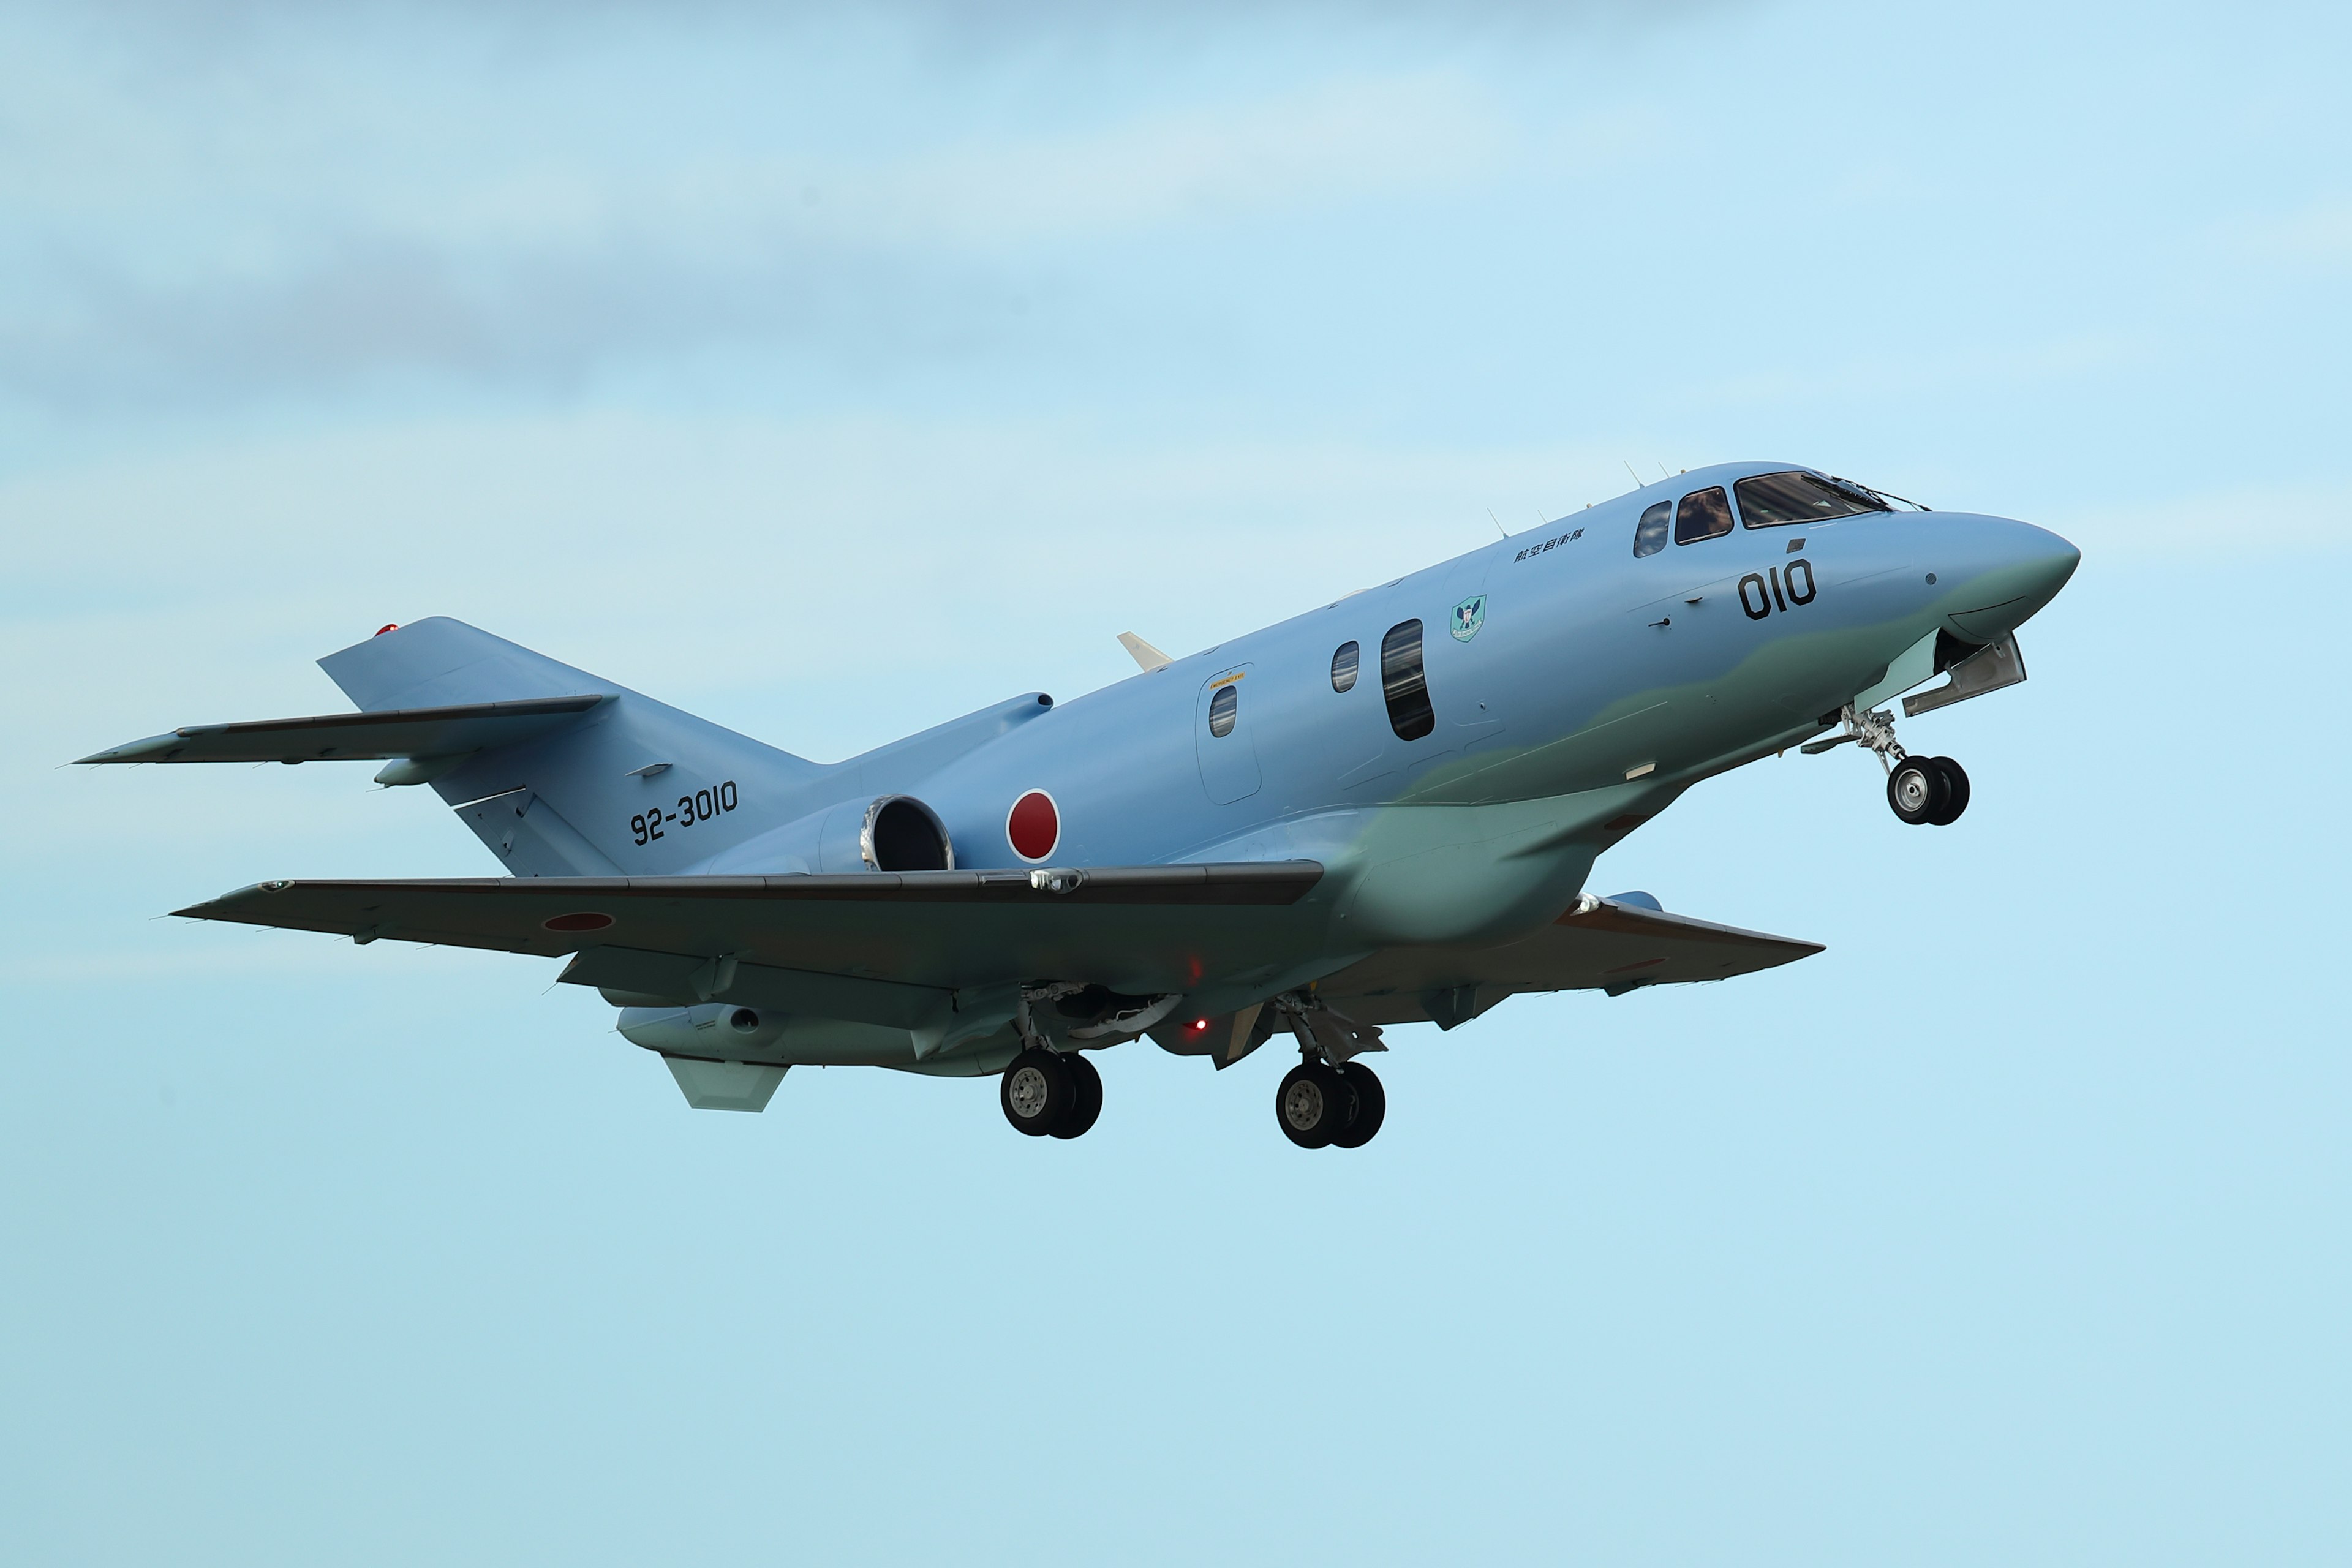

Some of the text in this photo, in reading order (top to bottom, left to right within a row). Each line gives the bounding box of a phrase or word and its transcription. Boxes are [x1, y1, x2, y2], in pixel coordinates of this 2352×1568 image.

[1513, 527, 1585, 563] 航空自衛隊
[1738, 558, 1817, 620] 010
[631, 780, 737, 846] 92-3010
